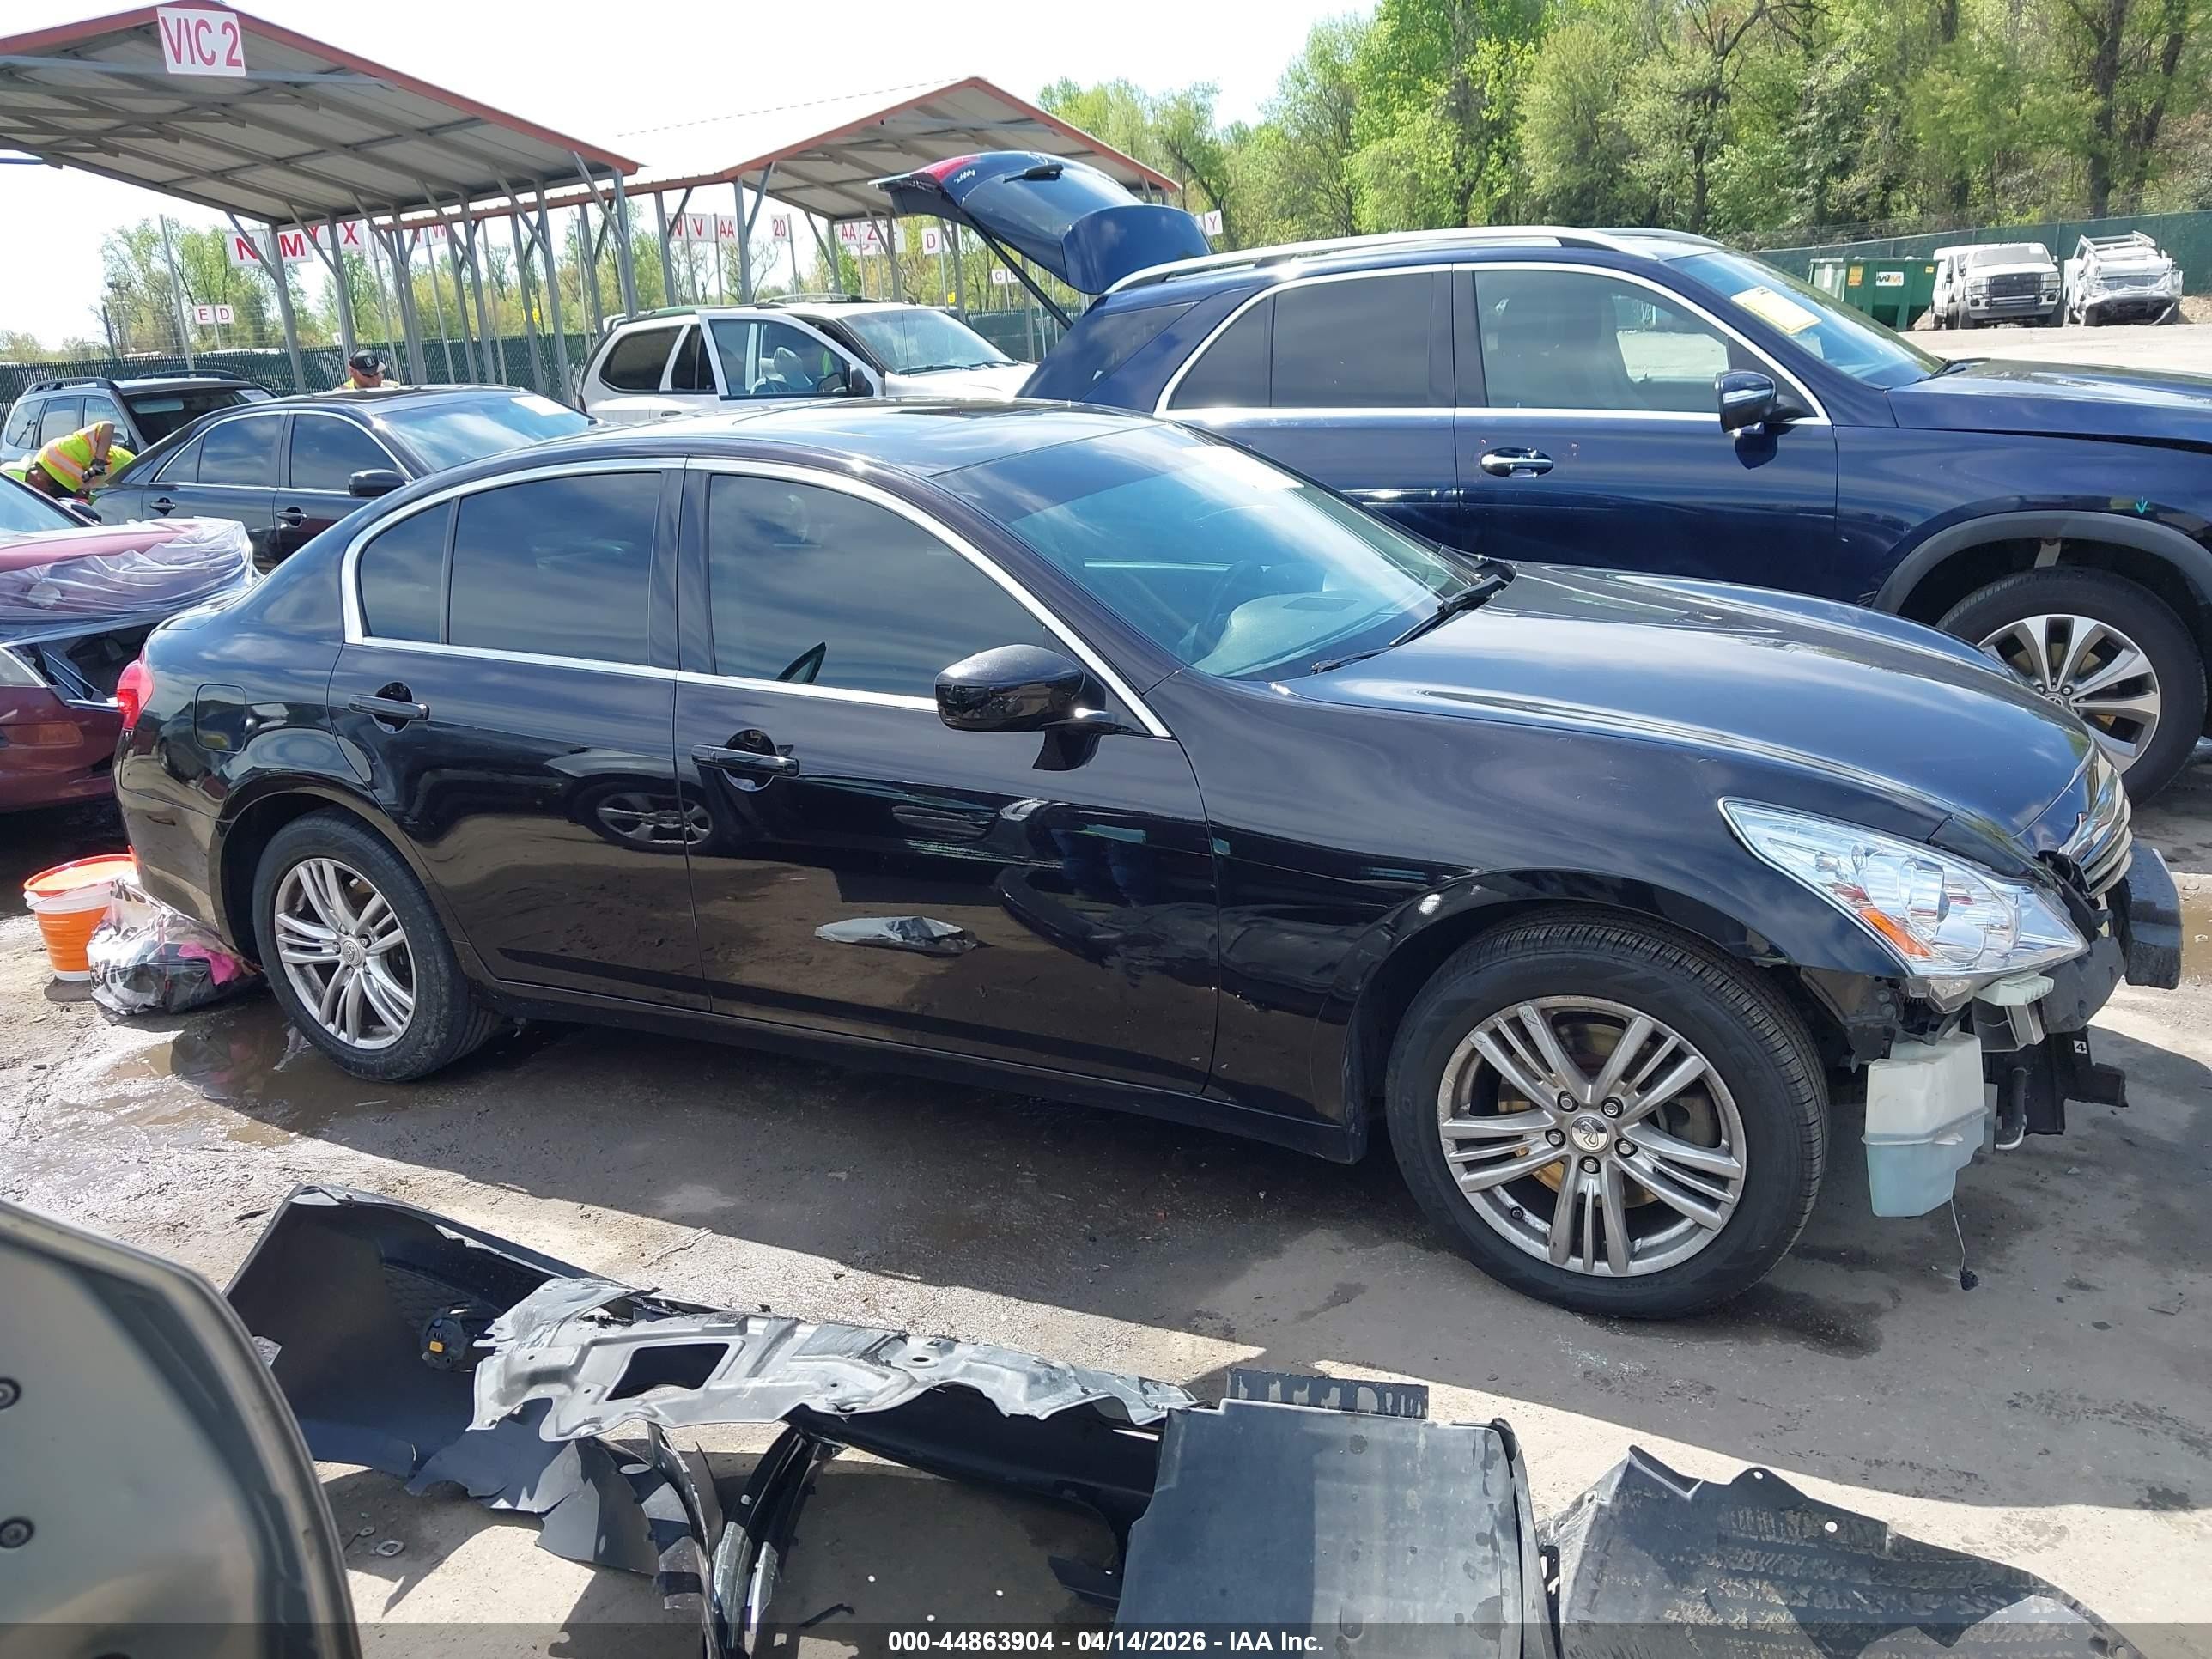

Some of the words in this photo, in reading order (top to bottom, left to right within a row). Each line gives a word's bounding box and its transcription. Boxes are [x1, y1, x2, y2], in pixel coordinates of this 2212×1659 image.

[160, 16, 216, 66] VIC
[222, 21, 242, 67] 2
[693, 218, 703, 236] V
[720, 219, 735, 238] AA
[774, 219, 786, 237] 20
[867, 223, 877, 240] Z
[1209, 216, 1217, 230] Y
[343, 221, 359, 245] X
[927, 233, 936, 249] D
[235, 237, 259, 260] N
[280, 234, 306, 258] M
[198, 308, 209, 320] E
[220, 307, 229, 319] D
[2076, 1042, 2087, 1052] 4
